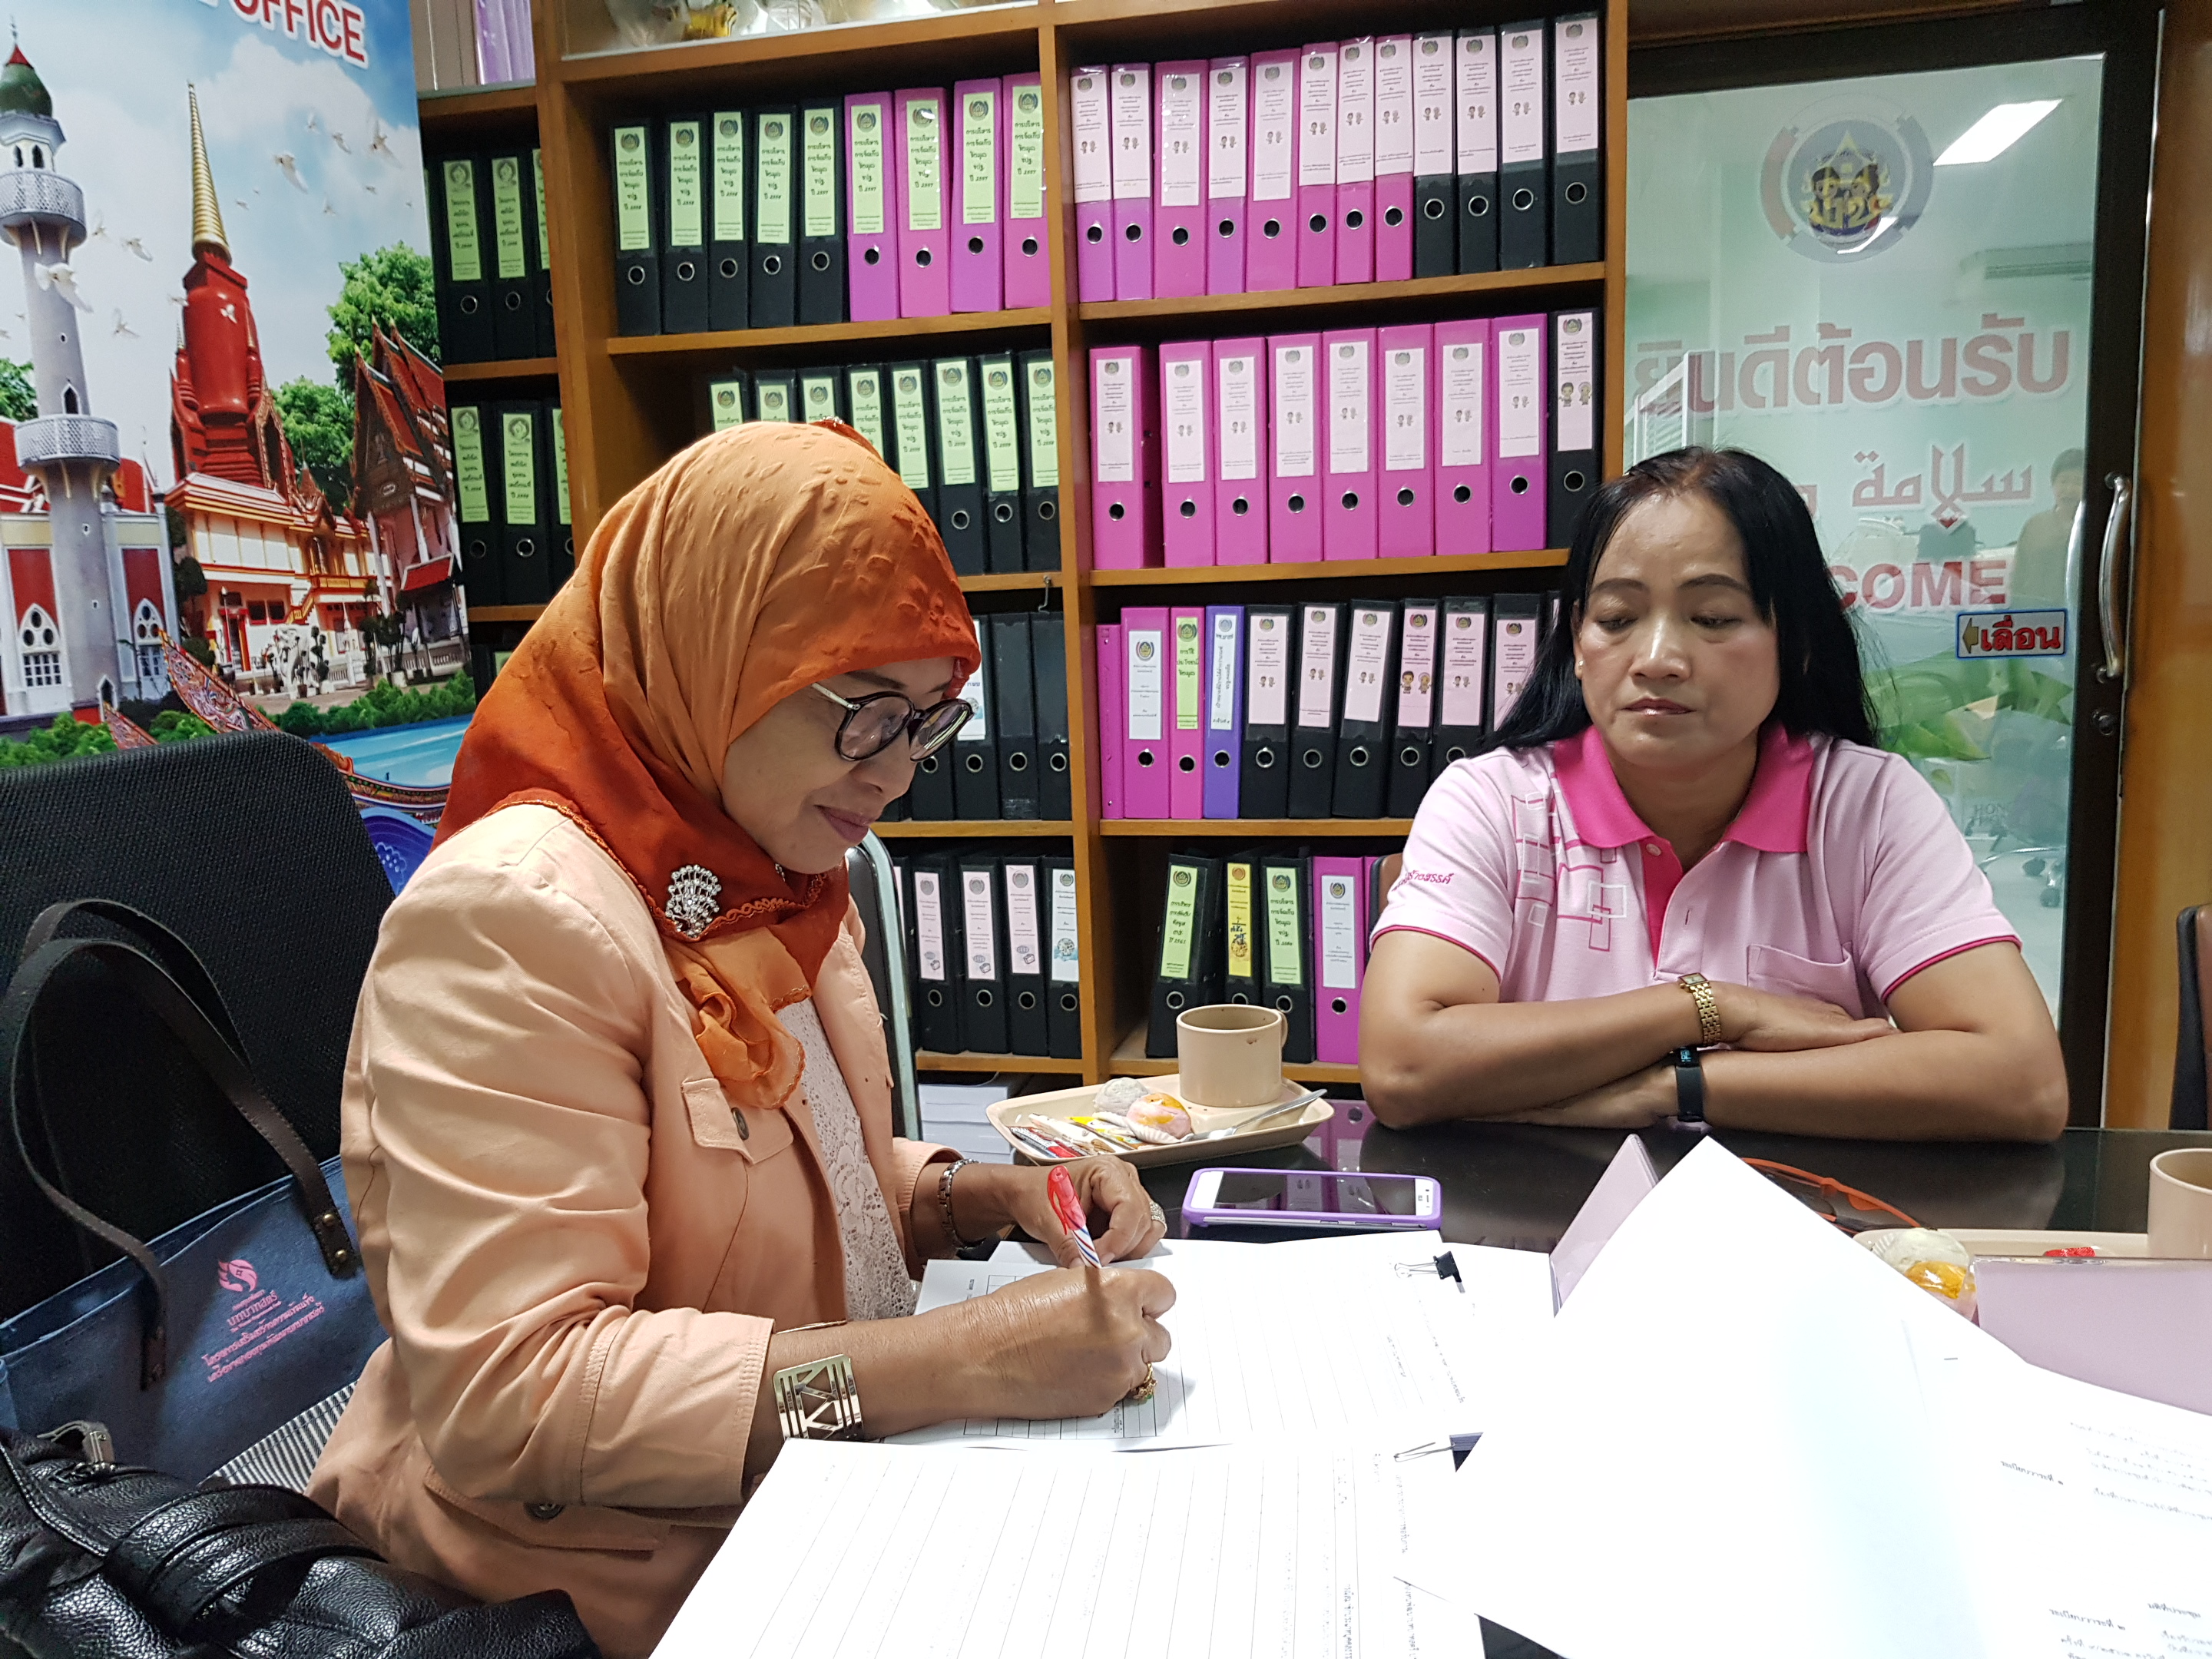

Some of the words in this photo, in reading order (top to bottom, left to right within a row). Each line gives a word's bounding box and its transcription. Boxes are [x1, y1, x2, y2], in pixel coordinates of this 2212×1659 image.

[1634, 312, 2071, 416] ยินดีต้อนรับ
[1980, 615, 2061, 652] เลื่อน
[227, 1290, 279, 1326] บทบาทสตรี
